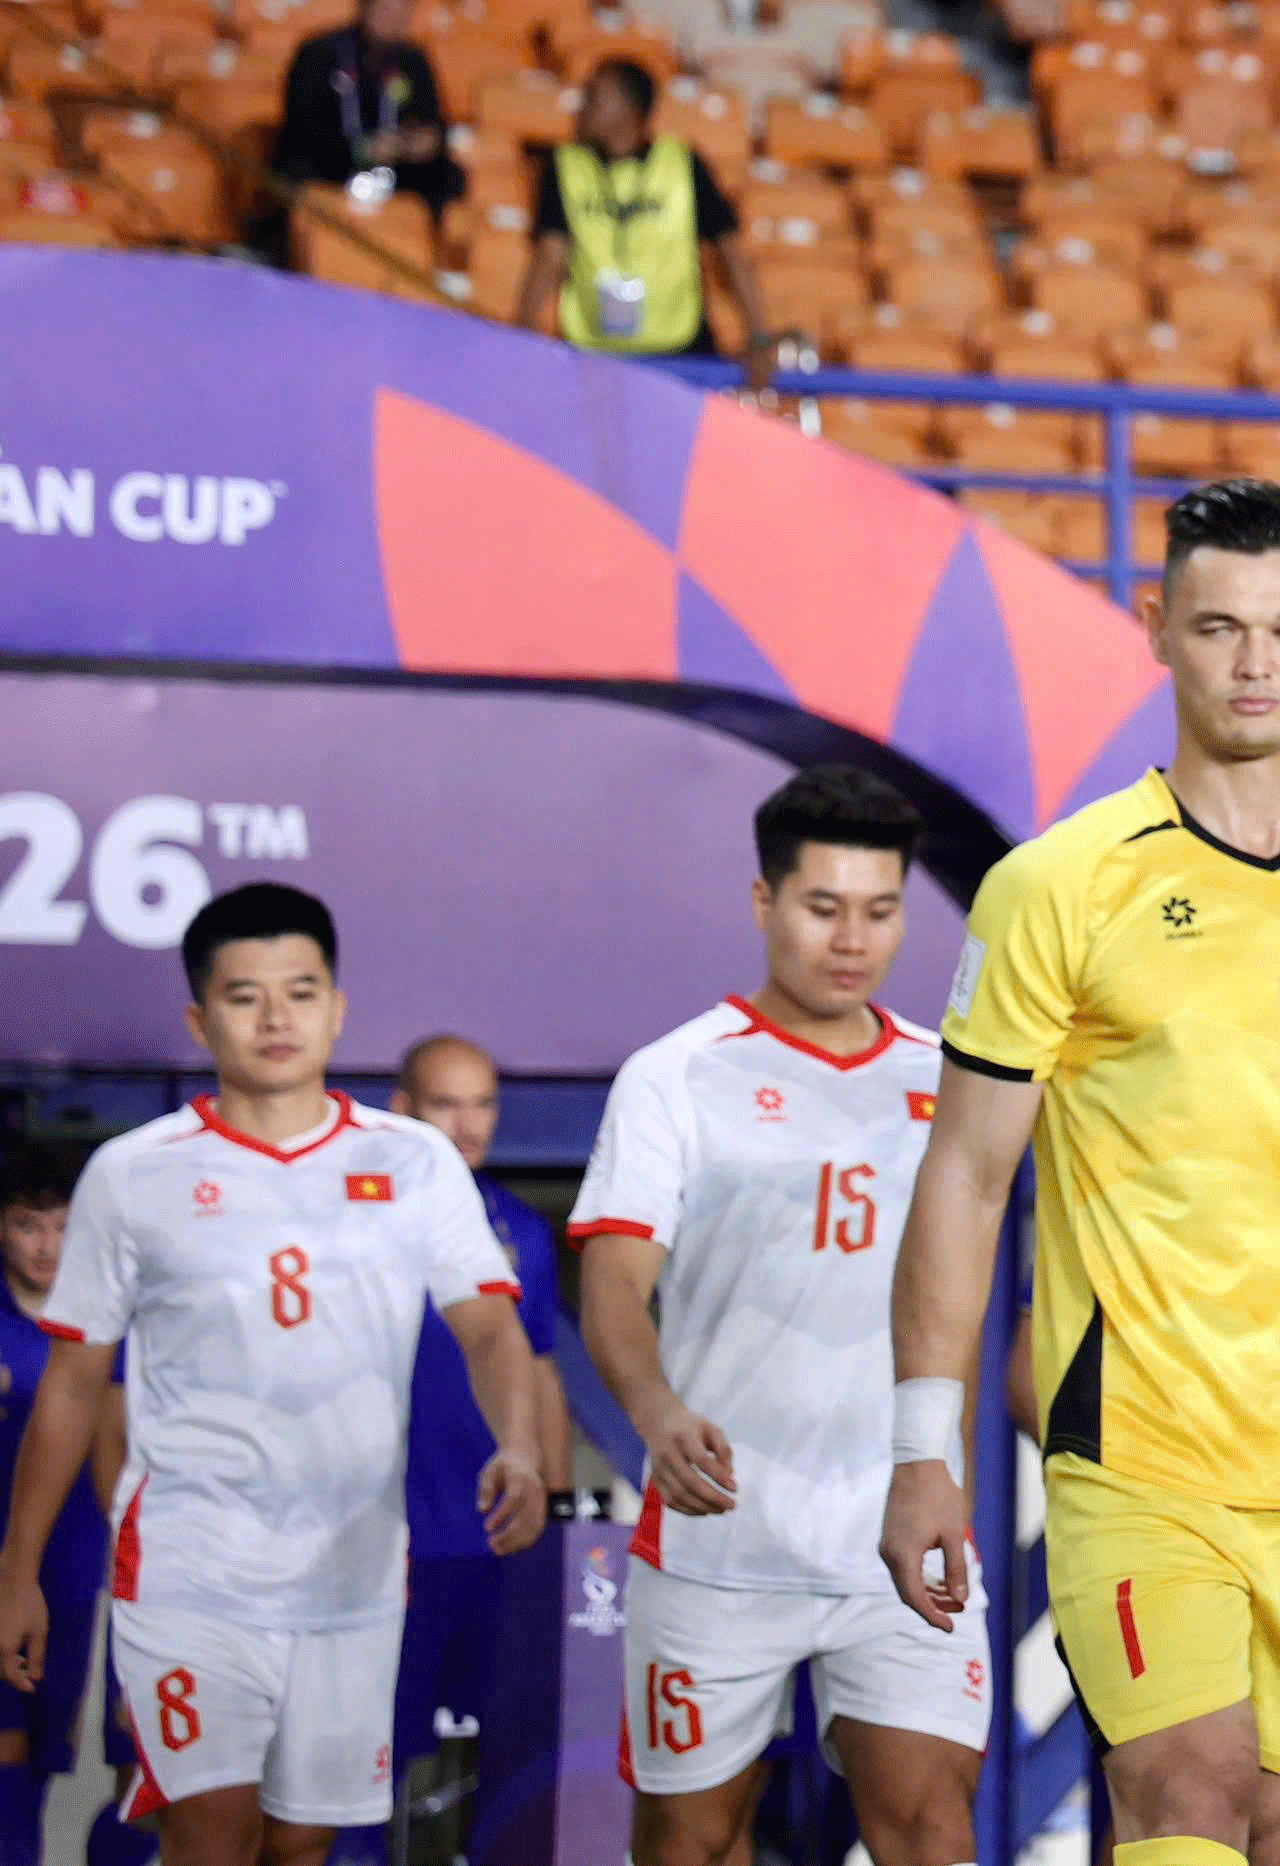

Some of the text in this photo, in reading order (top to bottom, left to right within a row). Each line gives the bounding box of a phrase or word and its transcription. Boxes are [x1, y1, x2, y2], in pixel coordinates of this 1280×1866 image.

[814, 1162, 878, 1255] 15
[270, 1246, 311, 1329] 8
[1116, 1578, 1146, 1679] 1
[156, 1667, 202, 1752] 8
[646, 1661, 704, 1756] 15
